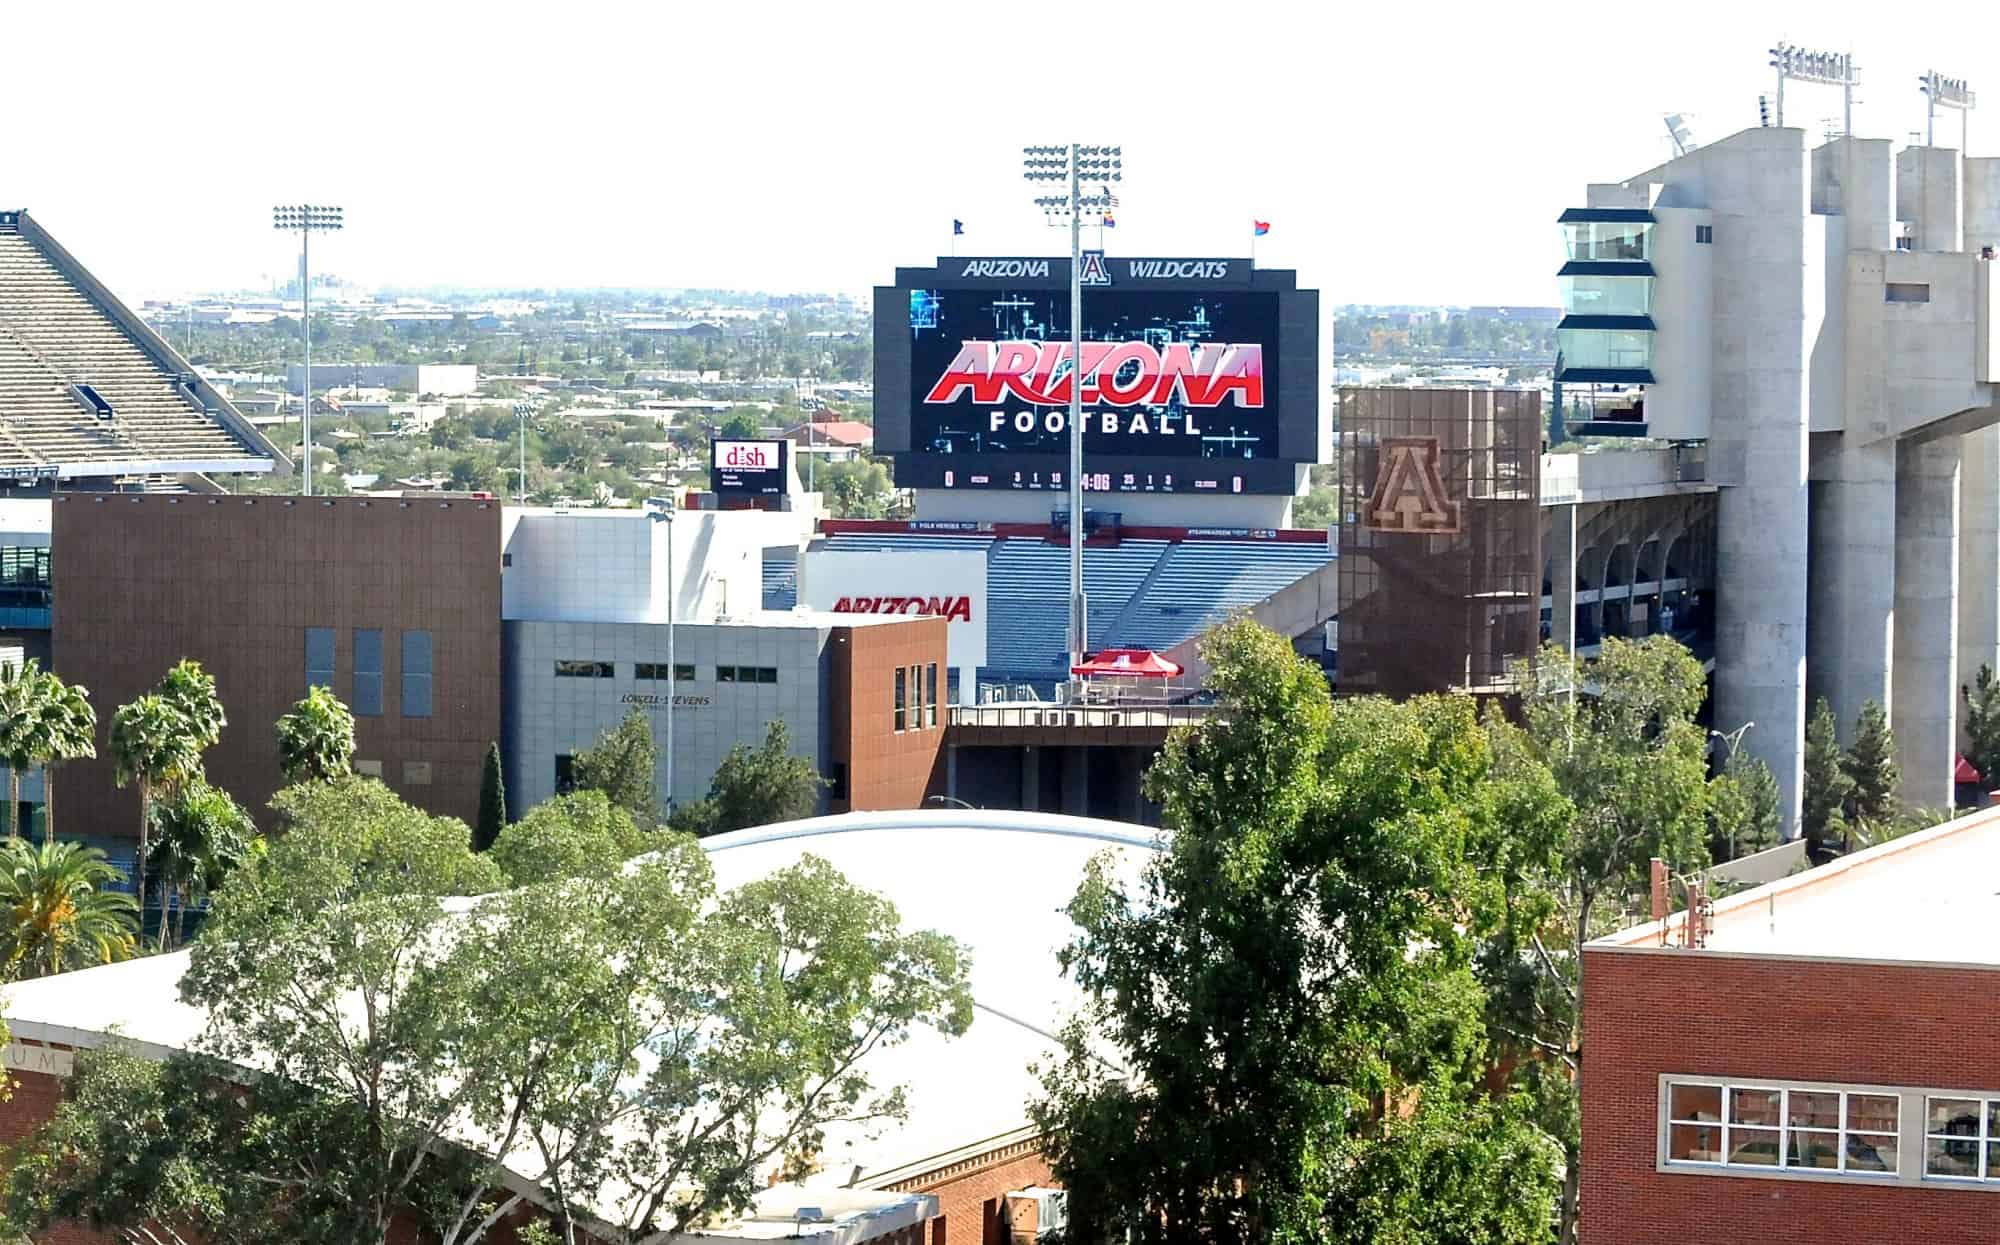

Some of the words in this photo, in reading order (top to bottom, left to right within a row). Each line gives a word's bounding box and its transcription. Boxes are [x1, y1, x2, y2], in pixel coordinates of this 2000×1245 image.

[962, 260, 1049, 277] ARIZONA
[1129, 261, 1227, 278] WILDCATS
[924, 340, 1264, 408] ARIZONA
[989, 411, 1201, 434] FOOTBALL
[726, 446, 766, 466] dish
